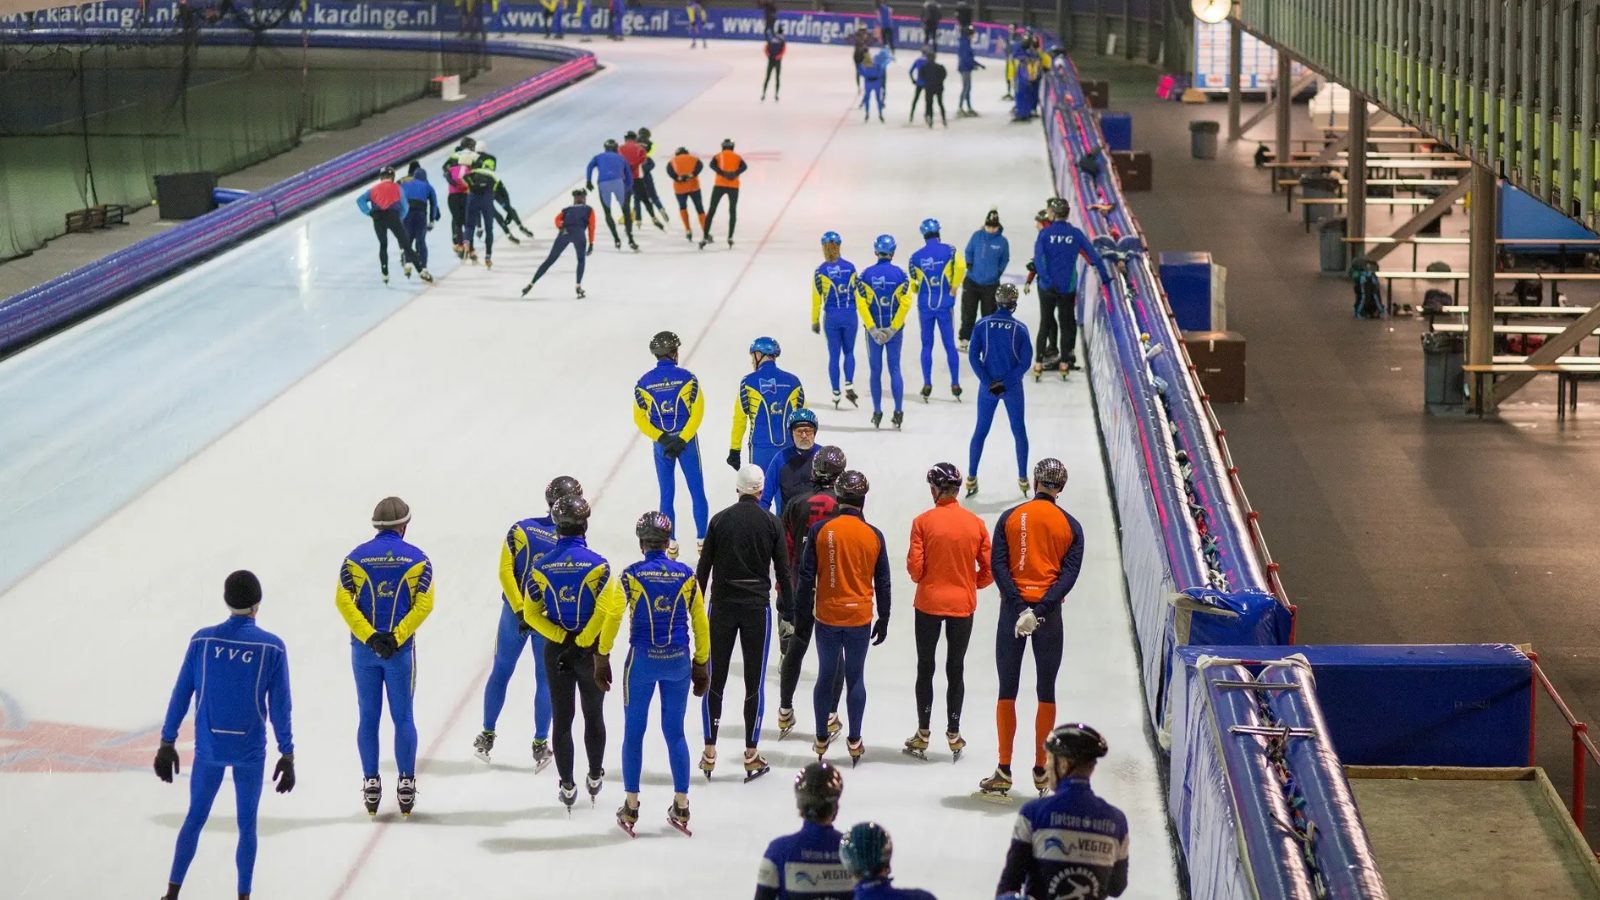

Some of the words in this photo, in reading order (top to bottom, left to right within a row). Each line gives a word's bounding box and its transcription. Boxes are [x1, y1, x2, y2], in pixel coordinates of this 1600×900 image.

[1049, 235, 1073, 244] YVG
[990, 321, 1012, 330] YVG
[214, 646, 254, 663] YVG
[822, 870, 849, 880] VEGTE
